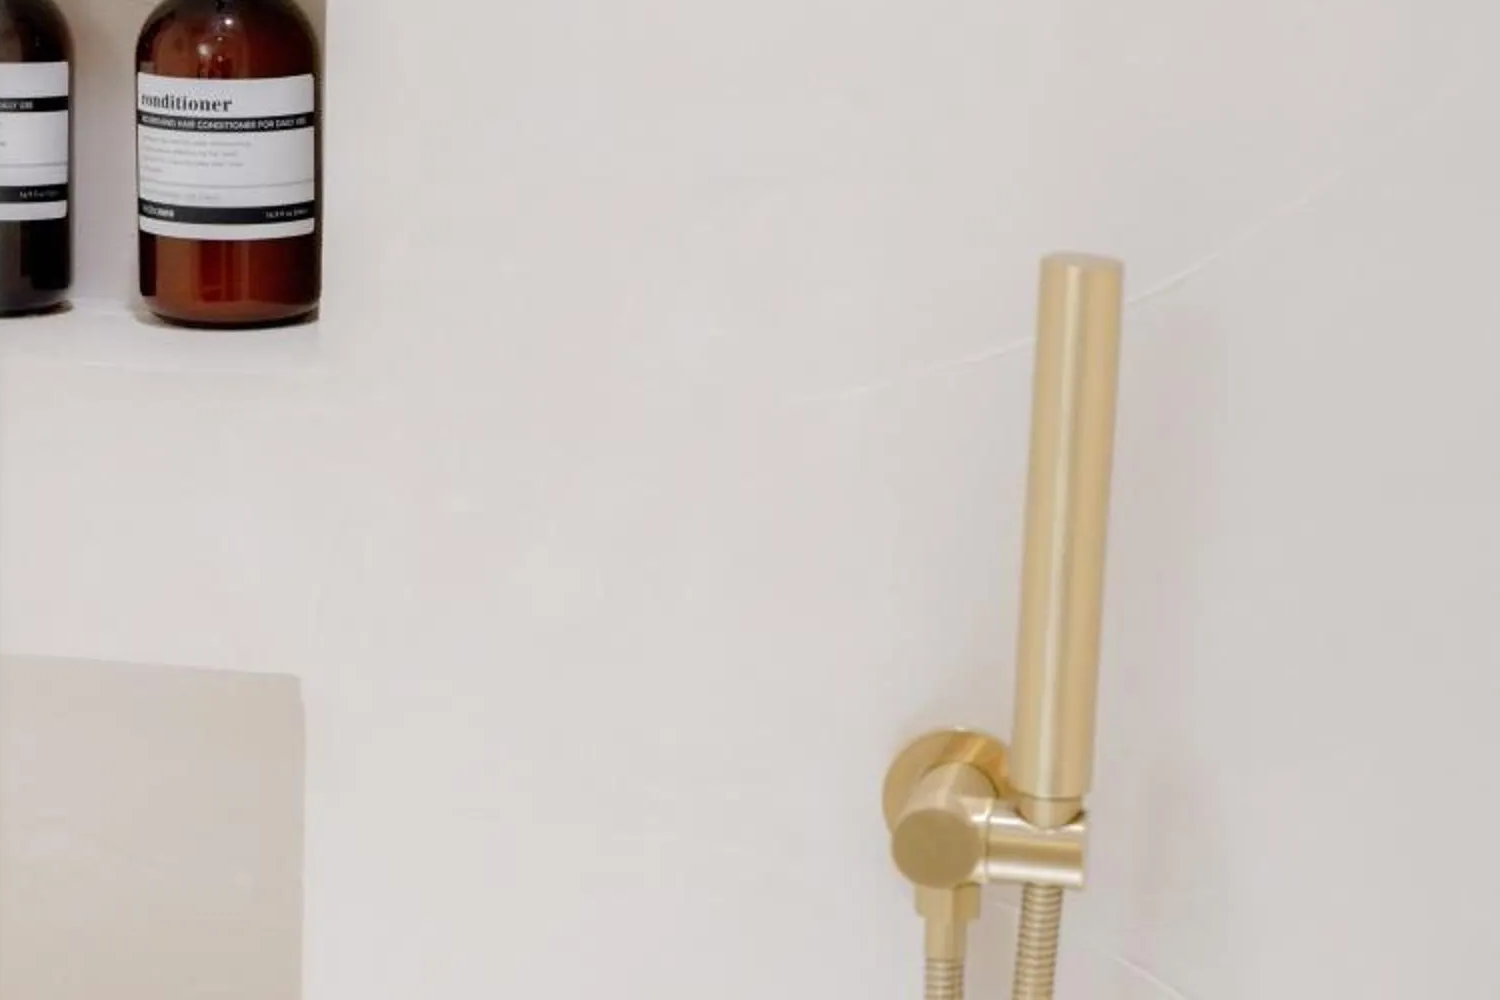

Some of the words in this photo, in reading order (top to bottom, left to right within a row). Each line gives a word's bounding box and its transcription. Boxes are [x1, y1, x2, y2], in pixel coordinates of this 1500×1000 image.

[141, 94, 233, 112] conditioner
[197, 120, 256, 130] CONDITIONER
[258, 119, 274, 129] FOR
